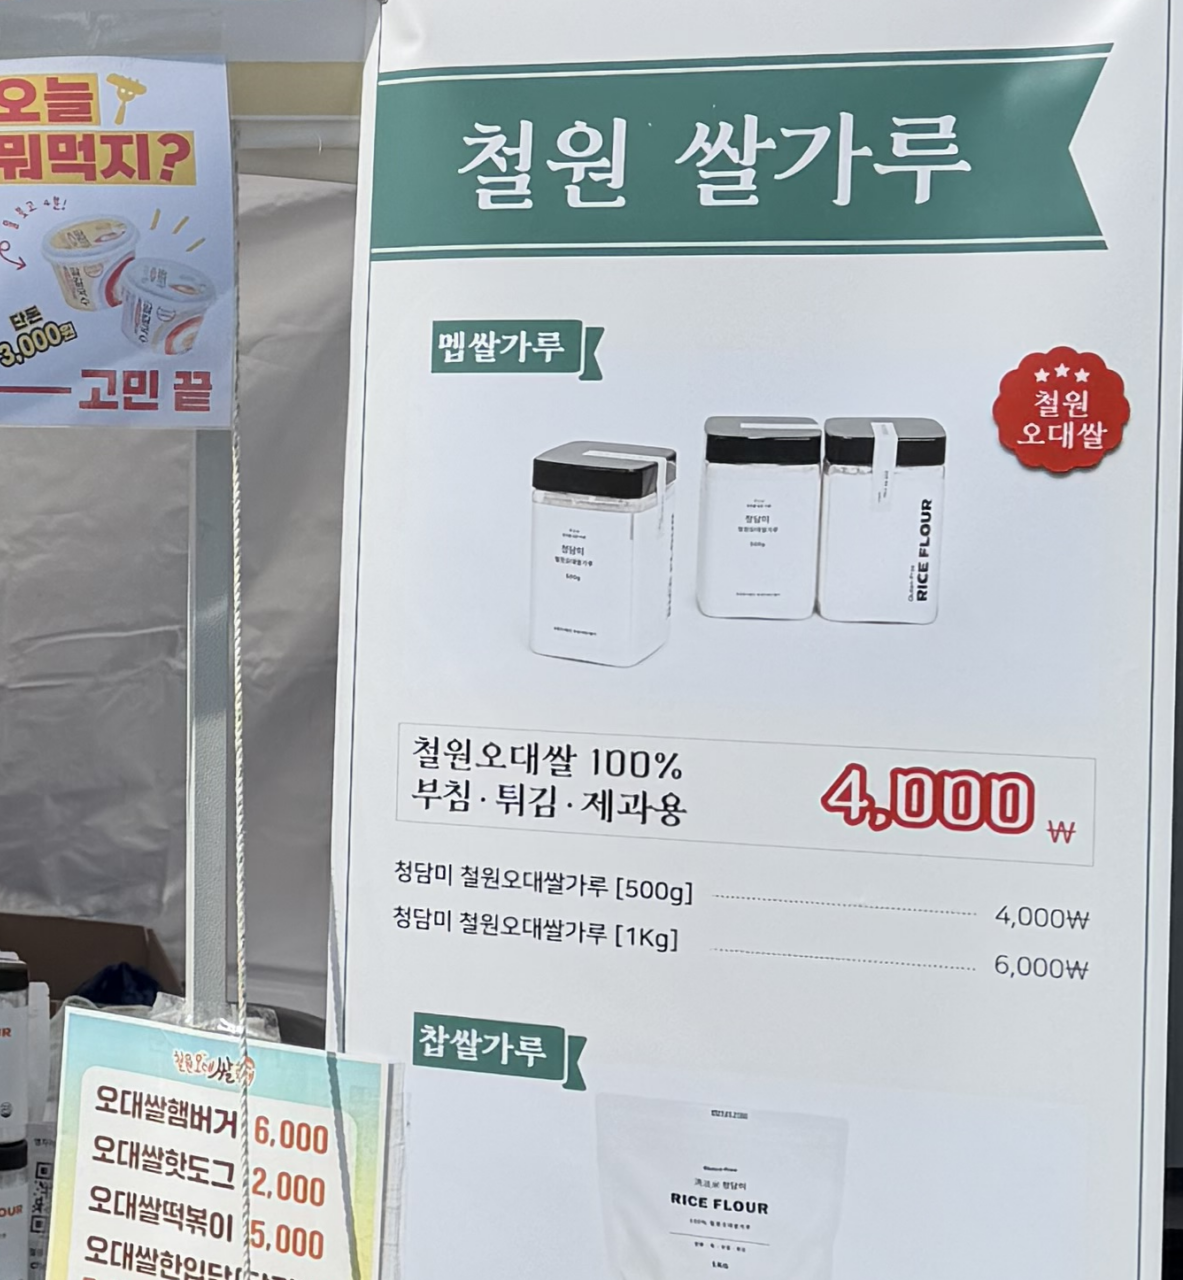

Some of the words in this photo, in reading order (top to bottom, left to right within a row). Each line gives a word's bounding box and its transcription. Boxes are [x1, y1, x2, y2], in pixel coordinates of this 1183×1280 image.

[457, 116, 628, 210] 철원
[674, 111, 973, 207] 쌀가루
[436, 329, 565, 366] 멥쌀가루
[78, 369, 158, 411] 고민
[173, 371, 212, 411] 끝
[1033, 388, 1090, 418] 철원
[1016, 419, 1109, 450] 오대쌀
[918, 498, 932, 558] FLOUR
[916, 561, 929, 602] RICE
[413, 737, 577, 777] 철원오대쌀
[593, 749, 682, 779] 100%
[821, 762, 1035, 835] 4,000
[395, 860, 452, 886] 청담미
[461, 865, 608, 897] 철원오대쌀가루
[616, 877, 692, 906] [500g]
[393, 906, 451, 932] 청담미
[460, 912, 607, 945] 철원오대쌀가루
[616, 925, 677, 952] [1Kg]
[419, 1025, 547, 1067] 찹쌀가루
[95, 1085, 238, 1140] 오대쌀햄버거
[254, 1116, 329, 1155] 6,000
[92, 1135, 235, 1191] 오대쌀핫도그
[252, 1167, 326, 1207] 2,000
[88, 1186, 234, 1243] 오대쌀떡볶이
[250, 1219, 325, 1260] 5,000
[670, 1192, 709, 1209] RICE
[712, 1198, 769, 1215] FLOUR
